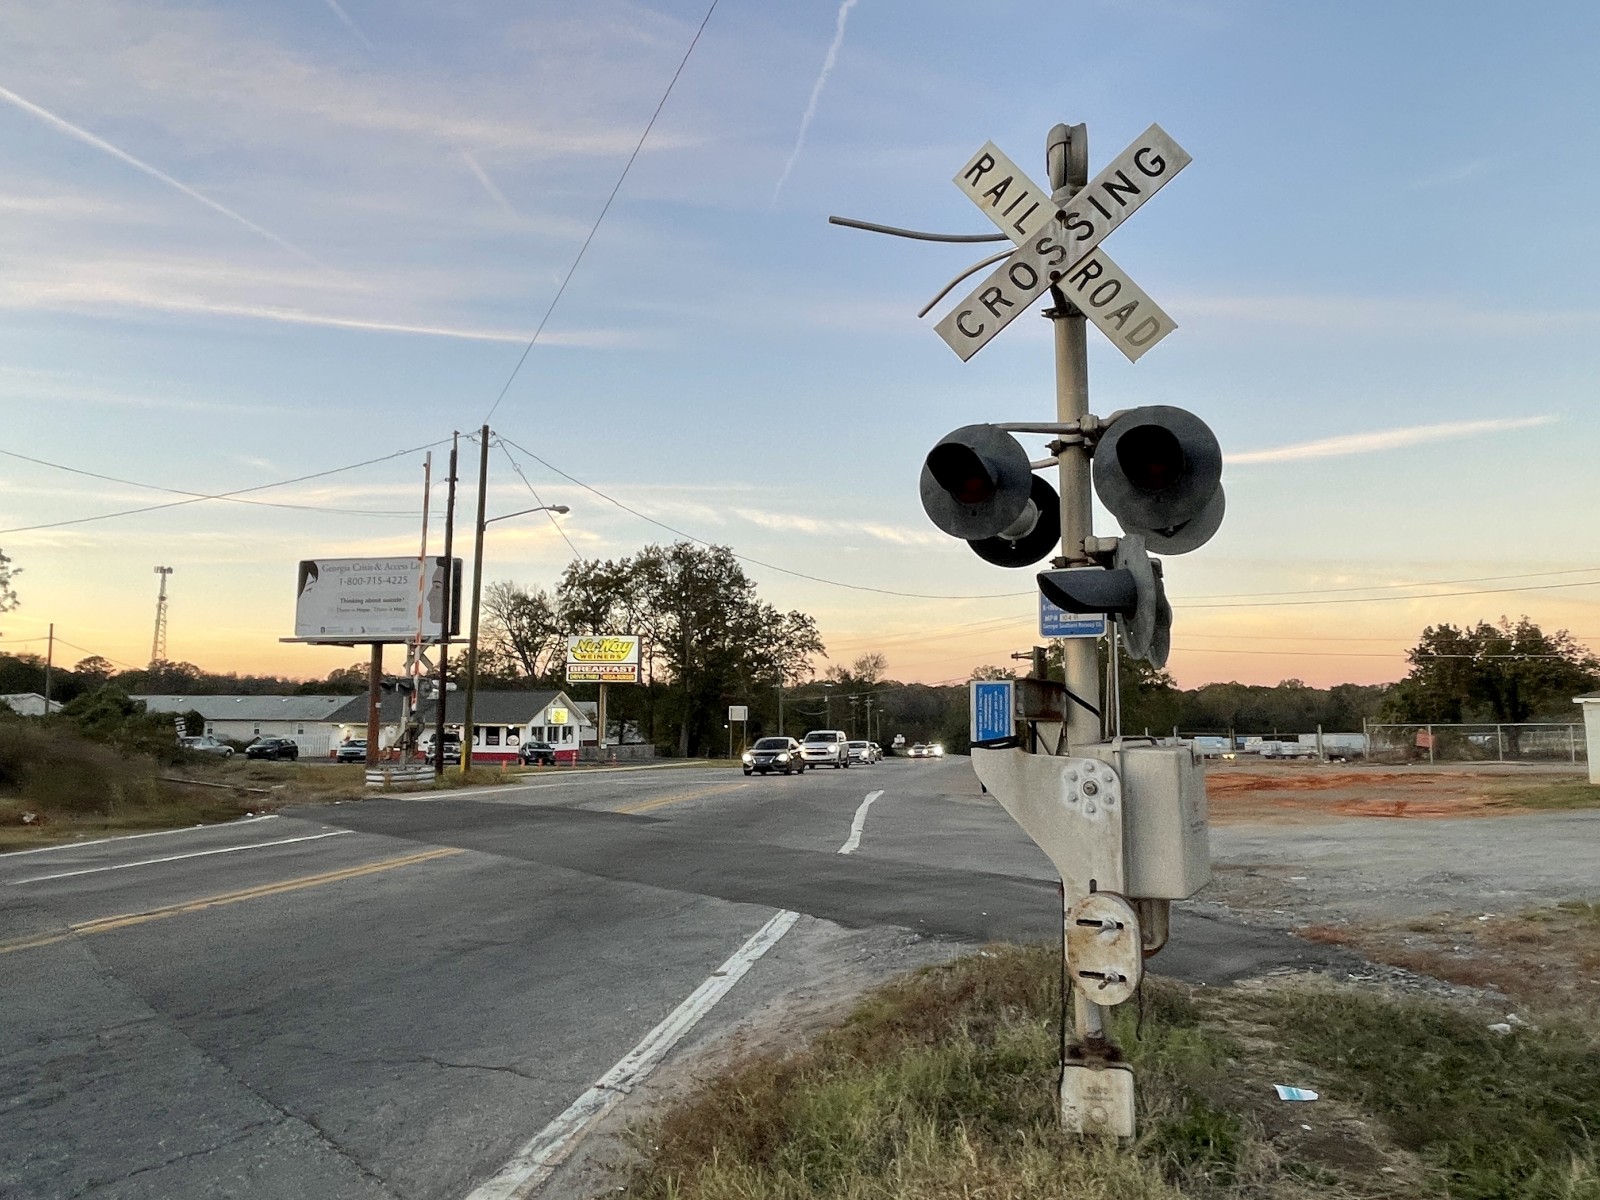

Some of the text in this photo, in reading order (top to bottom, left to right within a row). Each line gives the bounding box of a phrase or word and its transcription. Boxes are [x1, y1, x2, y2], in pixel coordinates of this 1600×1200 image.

[964, 152, 1040, 236] RAIL
[956, 147, 1166, 338] CROSSING
[1069, 258, 1161, 347] ROAD
[322, 564, 351, 574] Georgia
[352, 563, 373, 571] Crisis
[374, 563, 381, 571] &
[383, 562, 408, 570] Access
[339, 575, 409, 586] 1-800-715-4225
